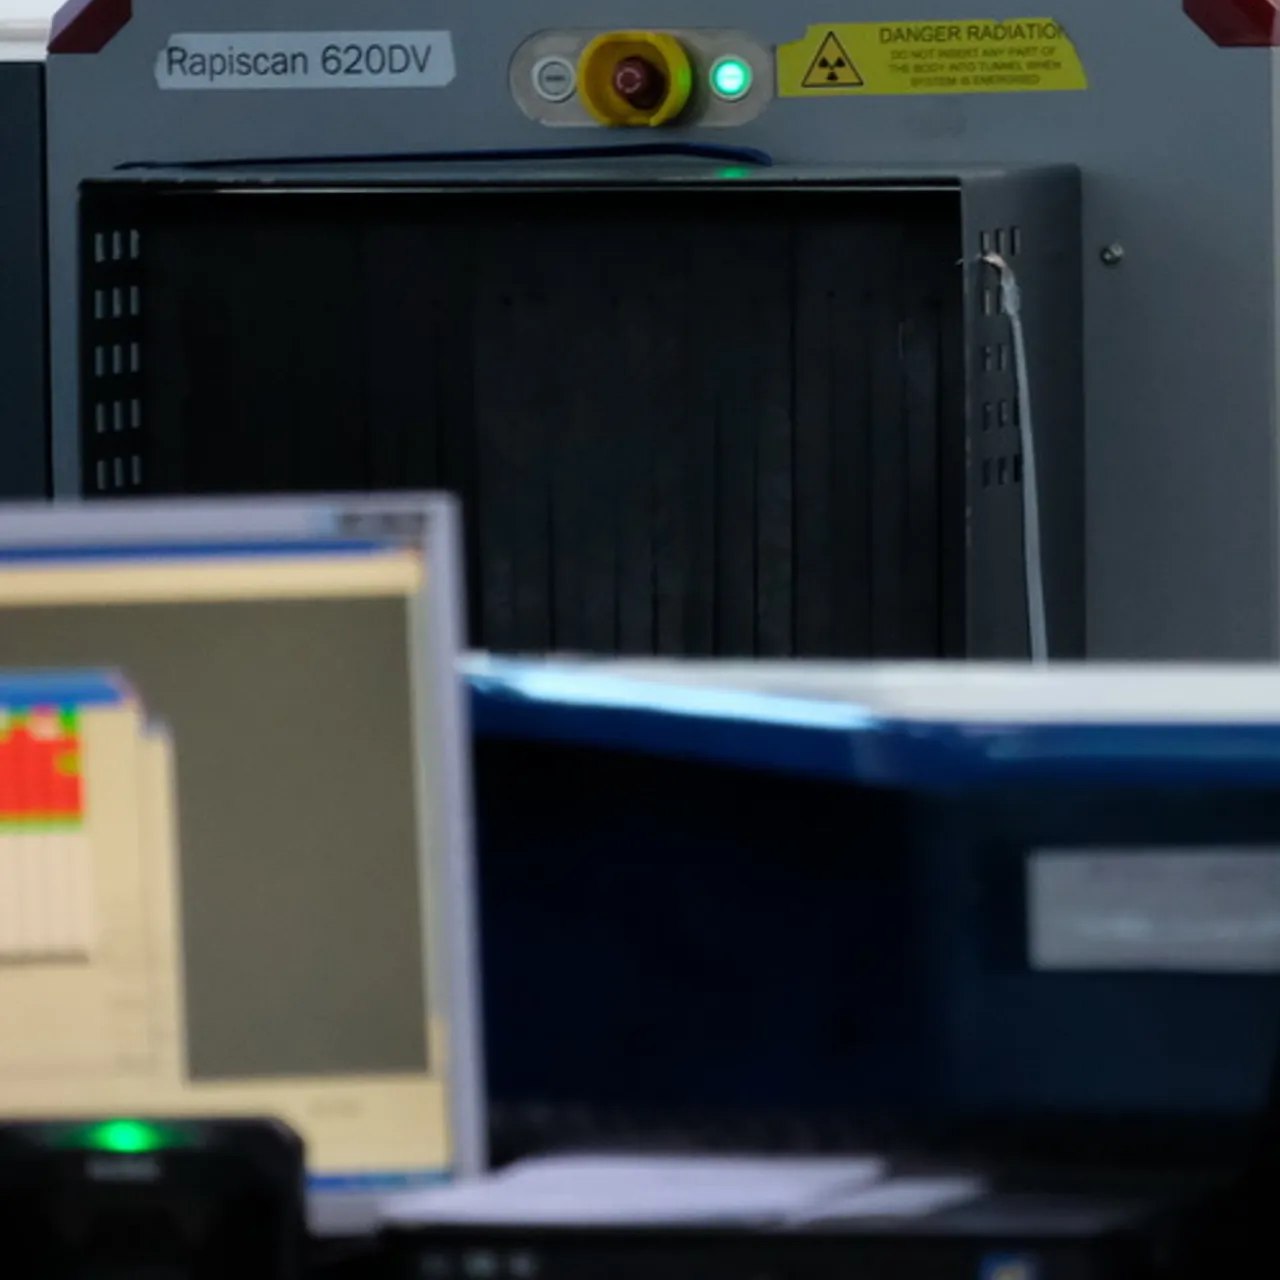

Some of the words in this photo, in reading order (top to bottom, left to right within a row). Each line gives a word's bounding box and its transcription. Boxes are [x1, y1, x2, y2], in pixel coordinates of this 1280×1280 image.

[879, 25, 961, 43] DANGER
[166, 46, 308, 81] Rapiscan
[320, 44, 431, 75] 620DV
[910, 48, 934, 59] NOT
